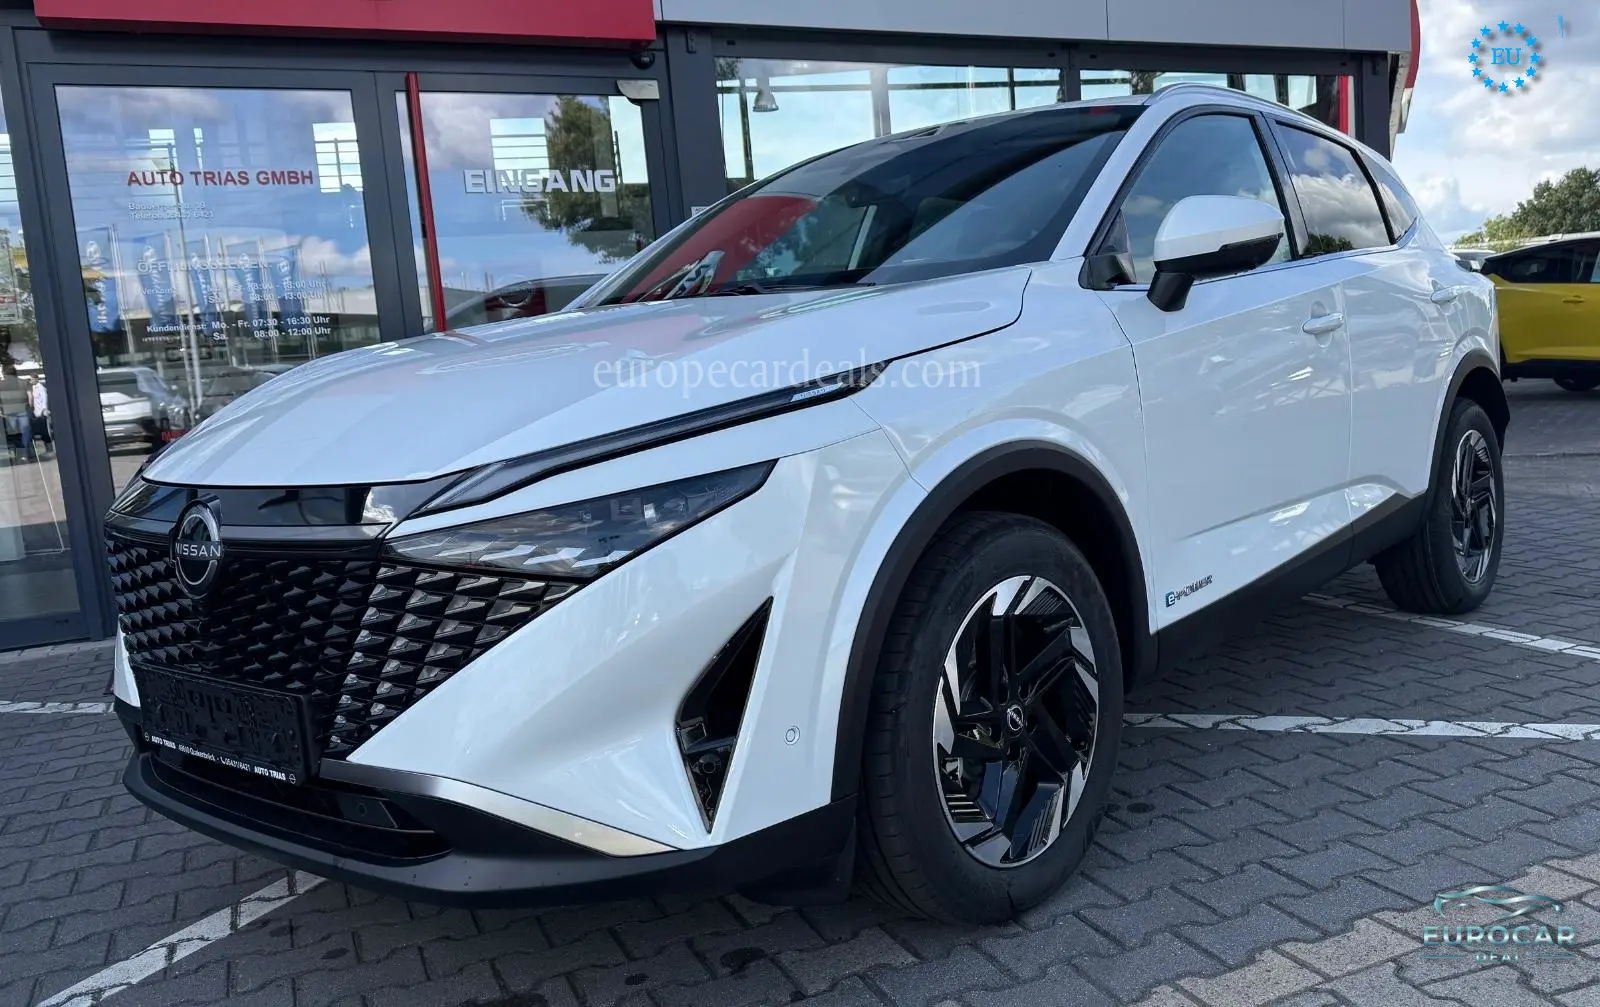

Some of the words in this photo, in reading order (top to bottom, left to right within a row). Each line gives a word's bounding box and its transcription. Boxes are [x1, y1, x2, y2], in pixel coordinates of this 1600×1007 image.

[127, 170, 184, 186] AUTO
[190, 170, 250, 186] TRIAS
[256, 170, 314, 186] GMBH
[463, 169, 616, 194] EINGANG
[212, 319, 229, 329] Mo.
[237, 318, 250, 328] Fr.
[252, 318, 278, 327] 07:30
[287, 316, 311, 326] 16:30
[313, 315, 330, 324] Uhr
[213, 331, 229, 340] Sa.
[253, 329, 279, 338] 08:00
[287, 327, 312, 336] 12:00
[314, 326, 331, 335] Uhr
[175, 542, 221, 557] NISSAN
[151, 735, 163, 745] AUTO
[254, 765, 269, 777] AUTO
[269, 769, 287, 781] TRIAS
